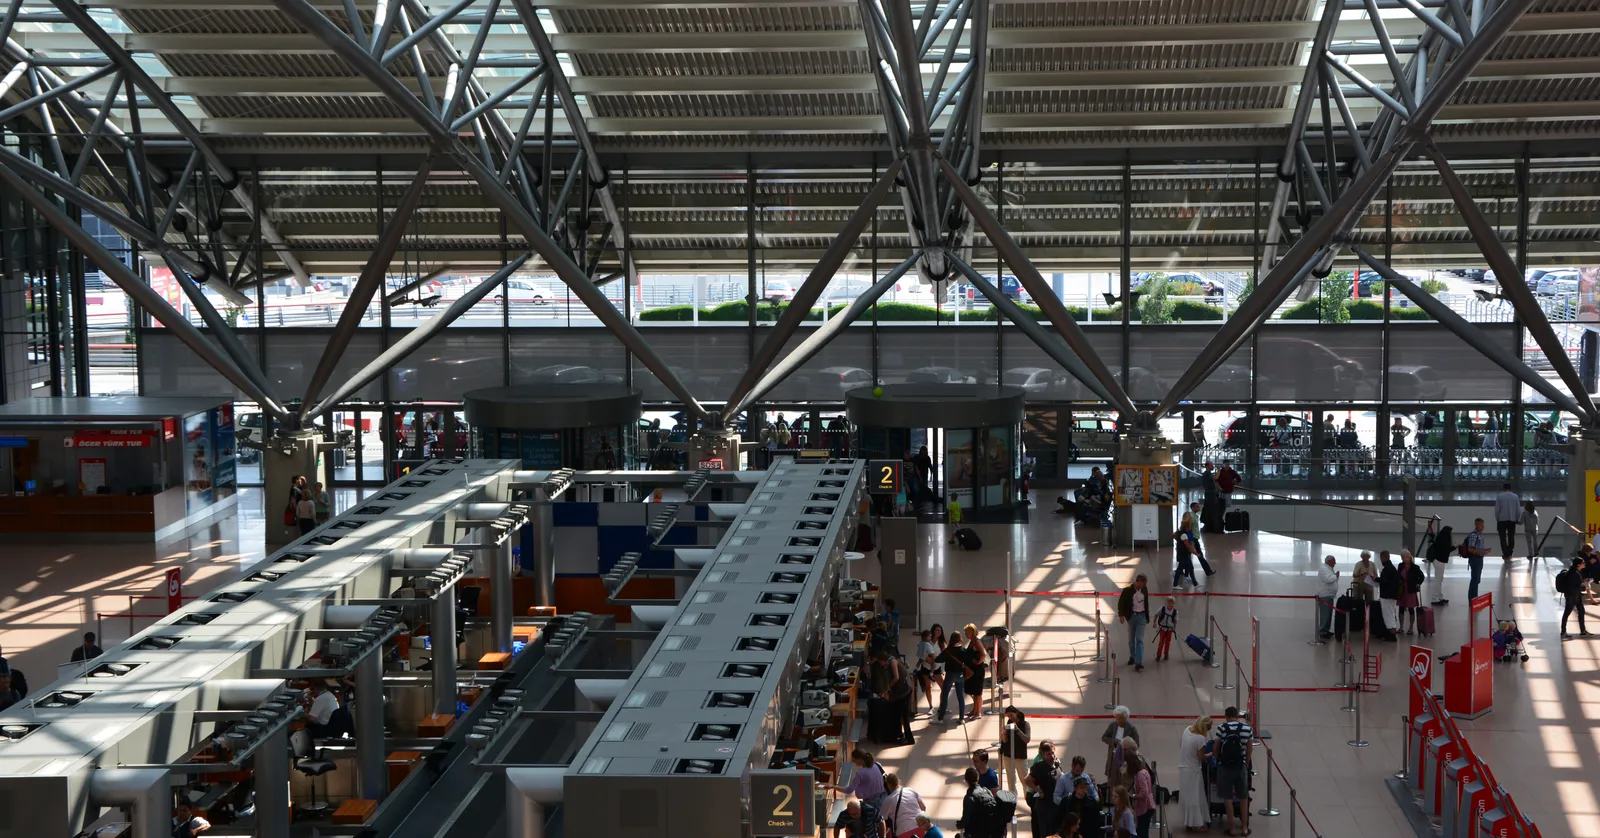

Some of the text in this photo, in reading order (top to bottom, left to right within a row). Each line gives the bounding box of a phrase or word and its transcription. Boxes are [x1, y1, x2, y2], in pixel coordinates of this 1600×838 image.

[79, 439, 101, 447] ÖGER
[103, 439, 124, 447] TÜRK
[881, 466, 892, 484] 2
[772, 784, 793, 816] 2
